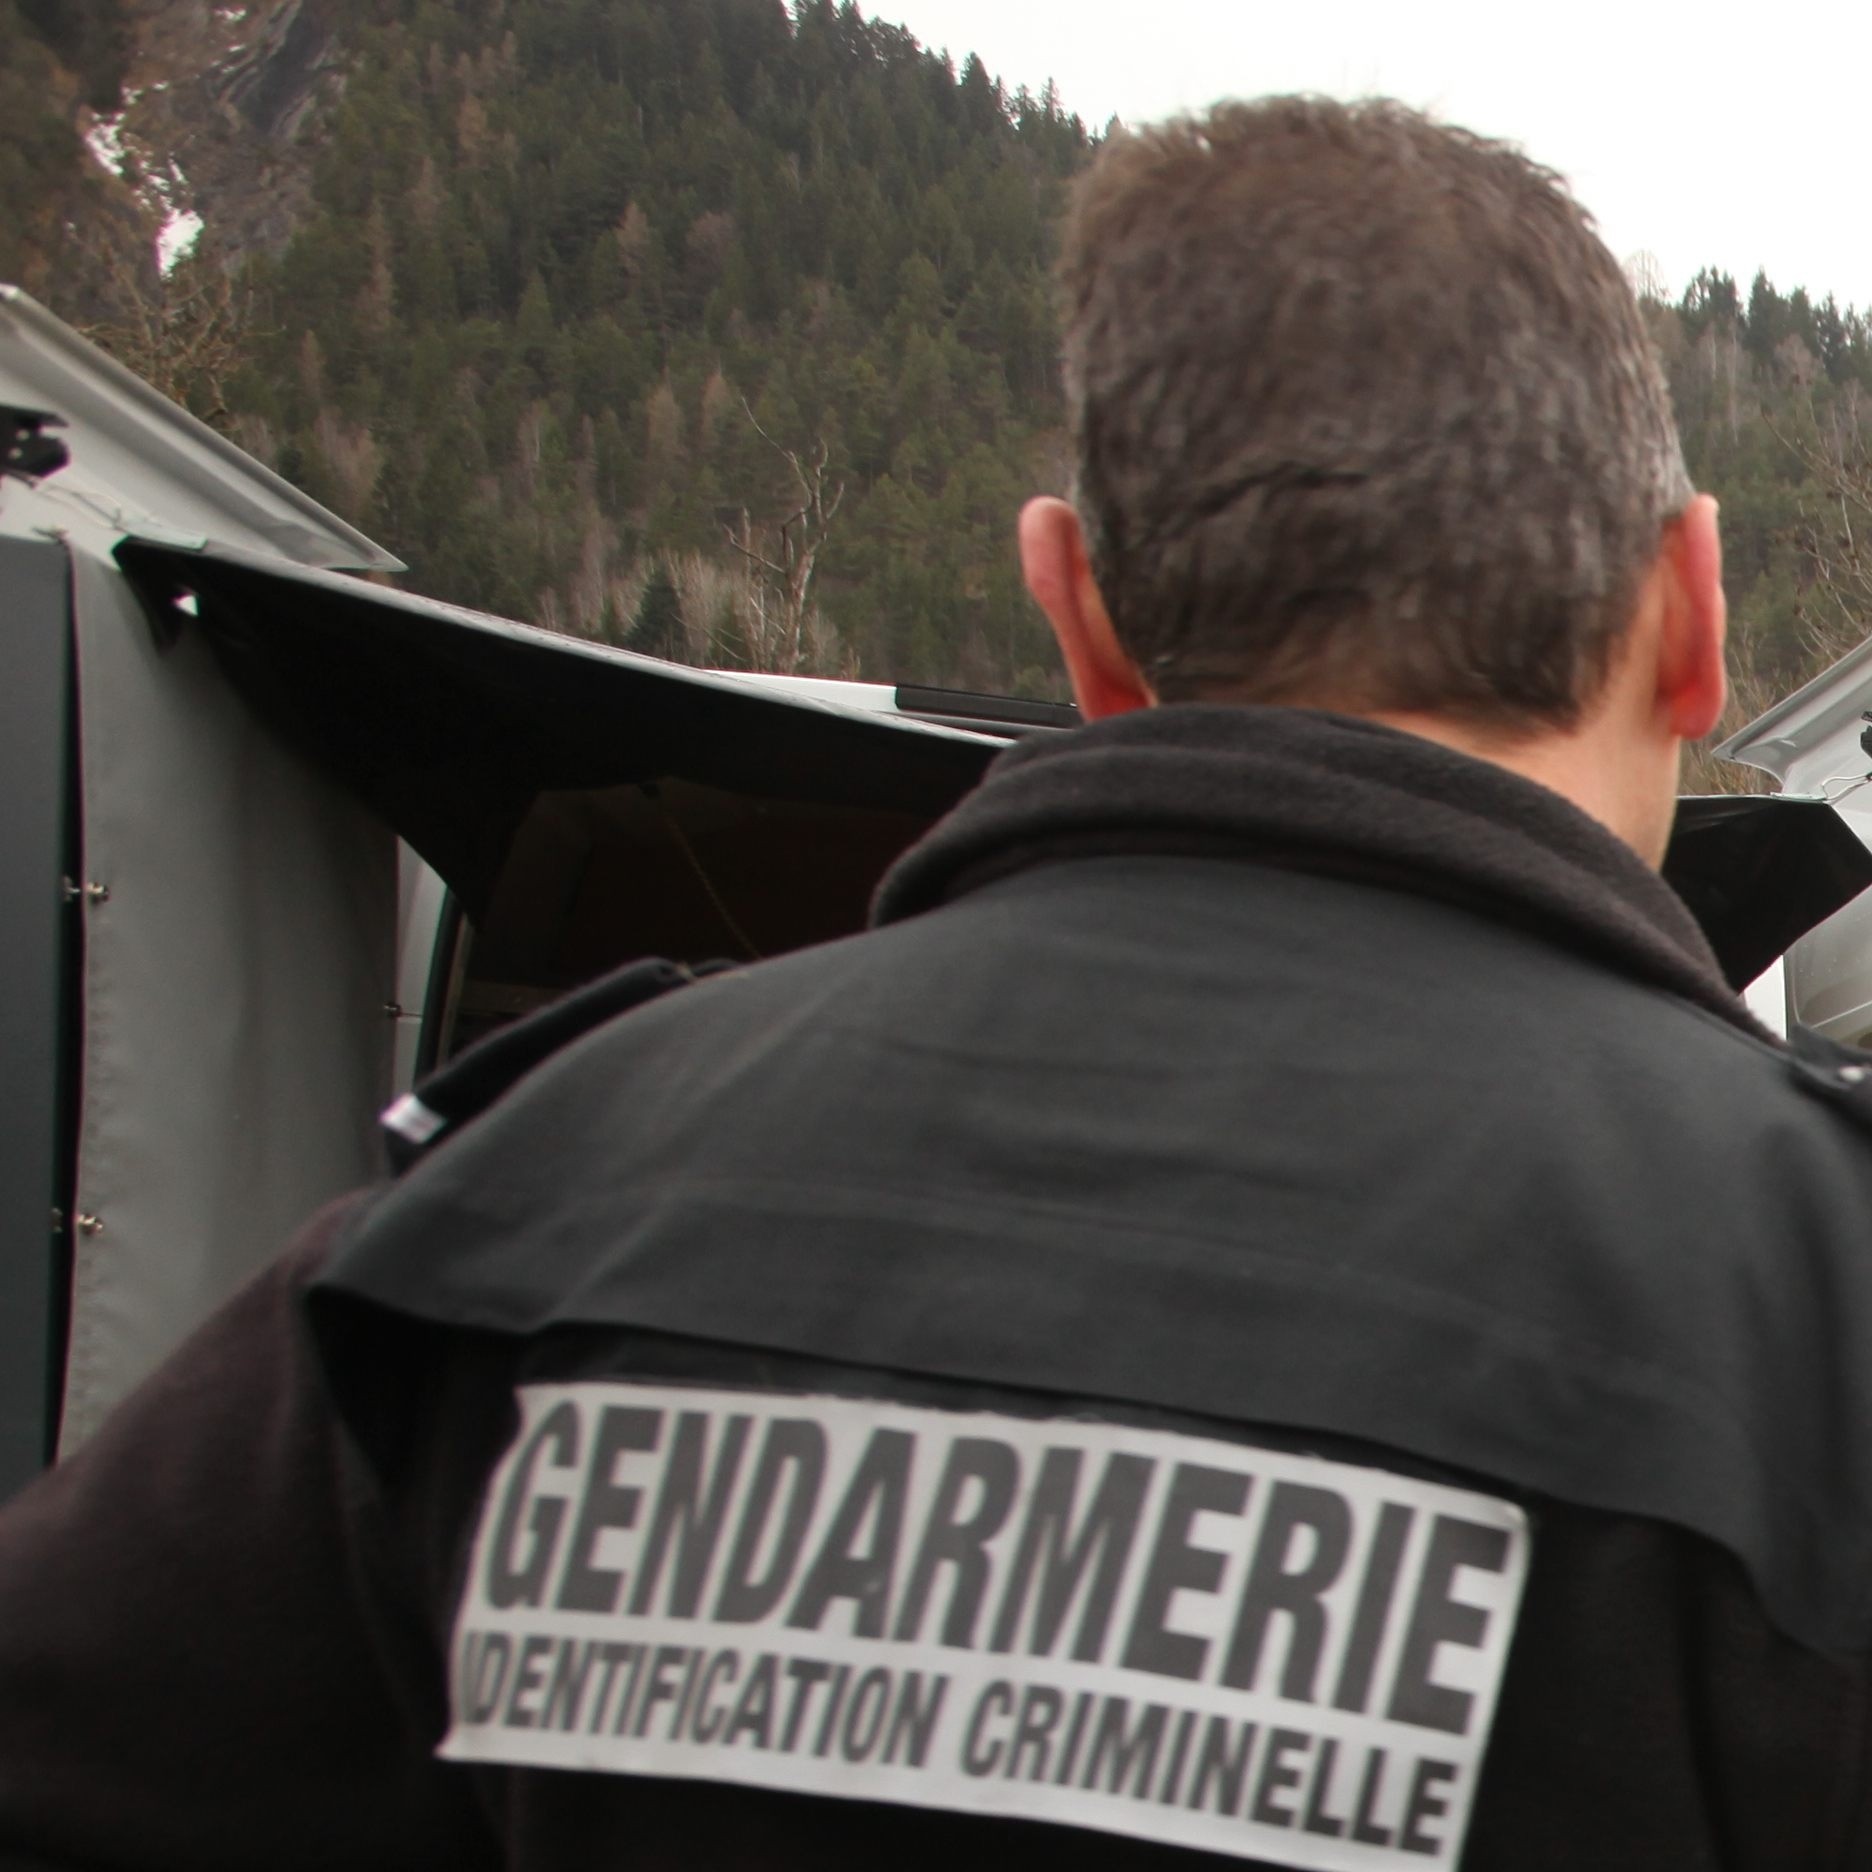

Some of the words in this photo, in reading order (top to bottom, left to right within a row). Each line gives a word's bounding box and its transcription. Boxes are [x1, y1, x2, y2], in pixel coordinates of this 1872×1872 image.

[484, 1399, 1510, 1738] GENDARMERIE
[460, 1629, 949, 1769] IDENTIFICATION
[961, 1679, 1460, 1857] CRIMINELLE
